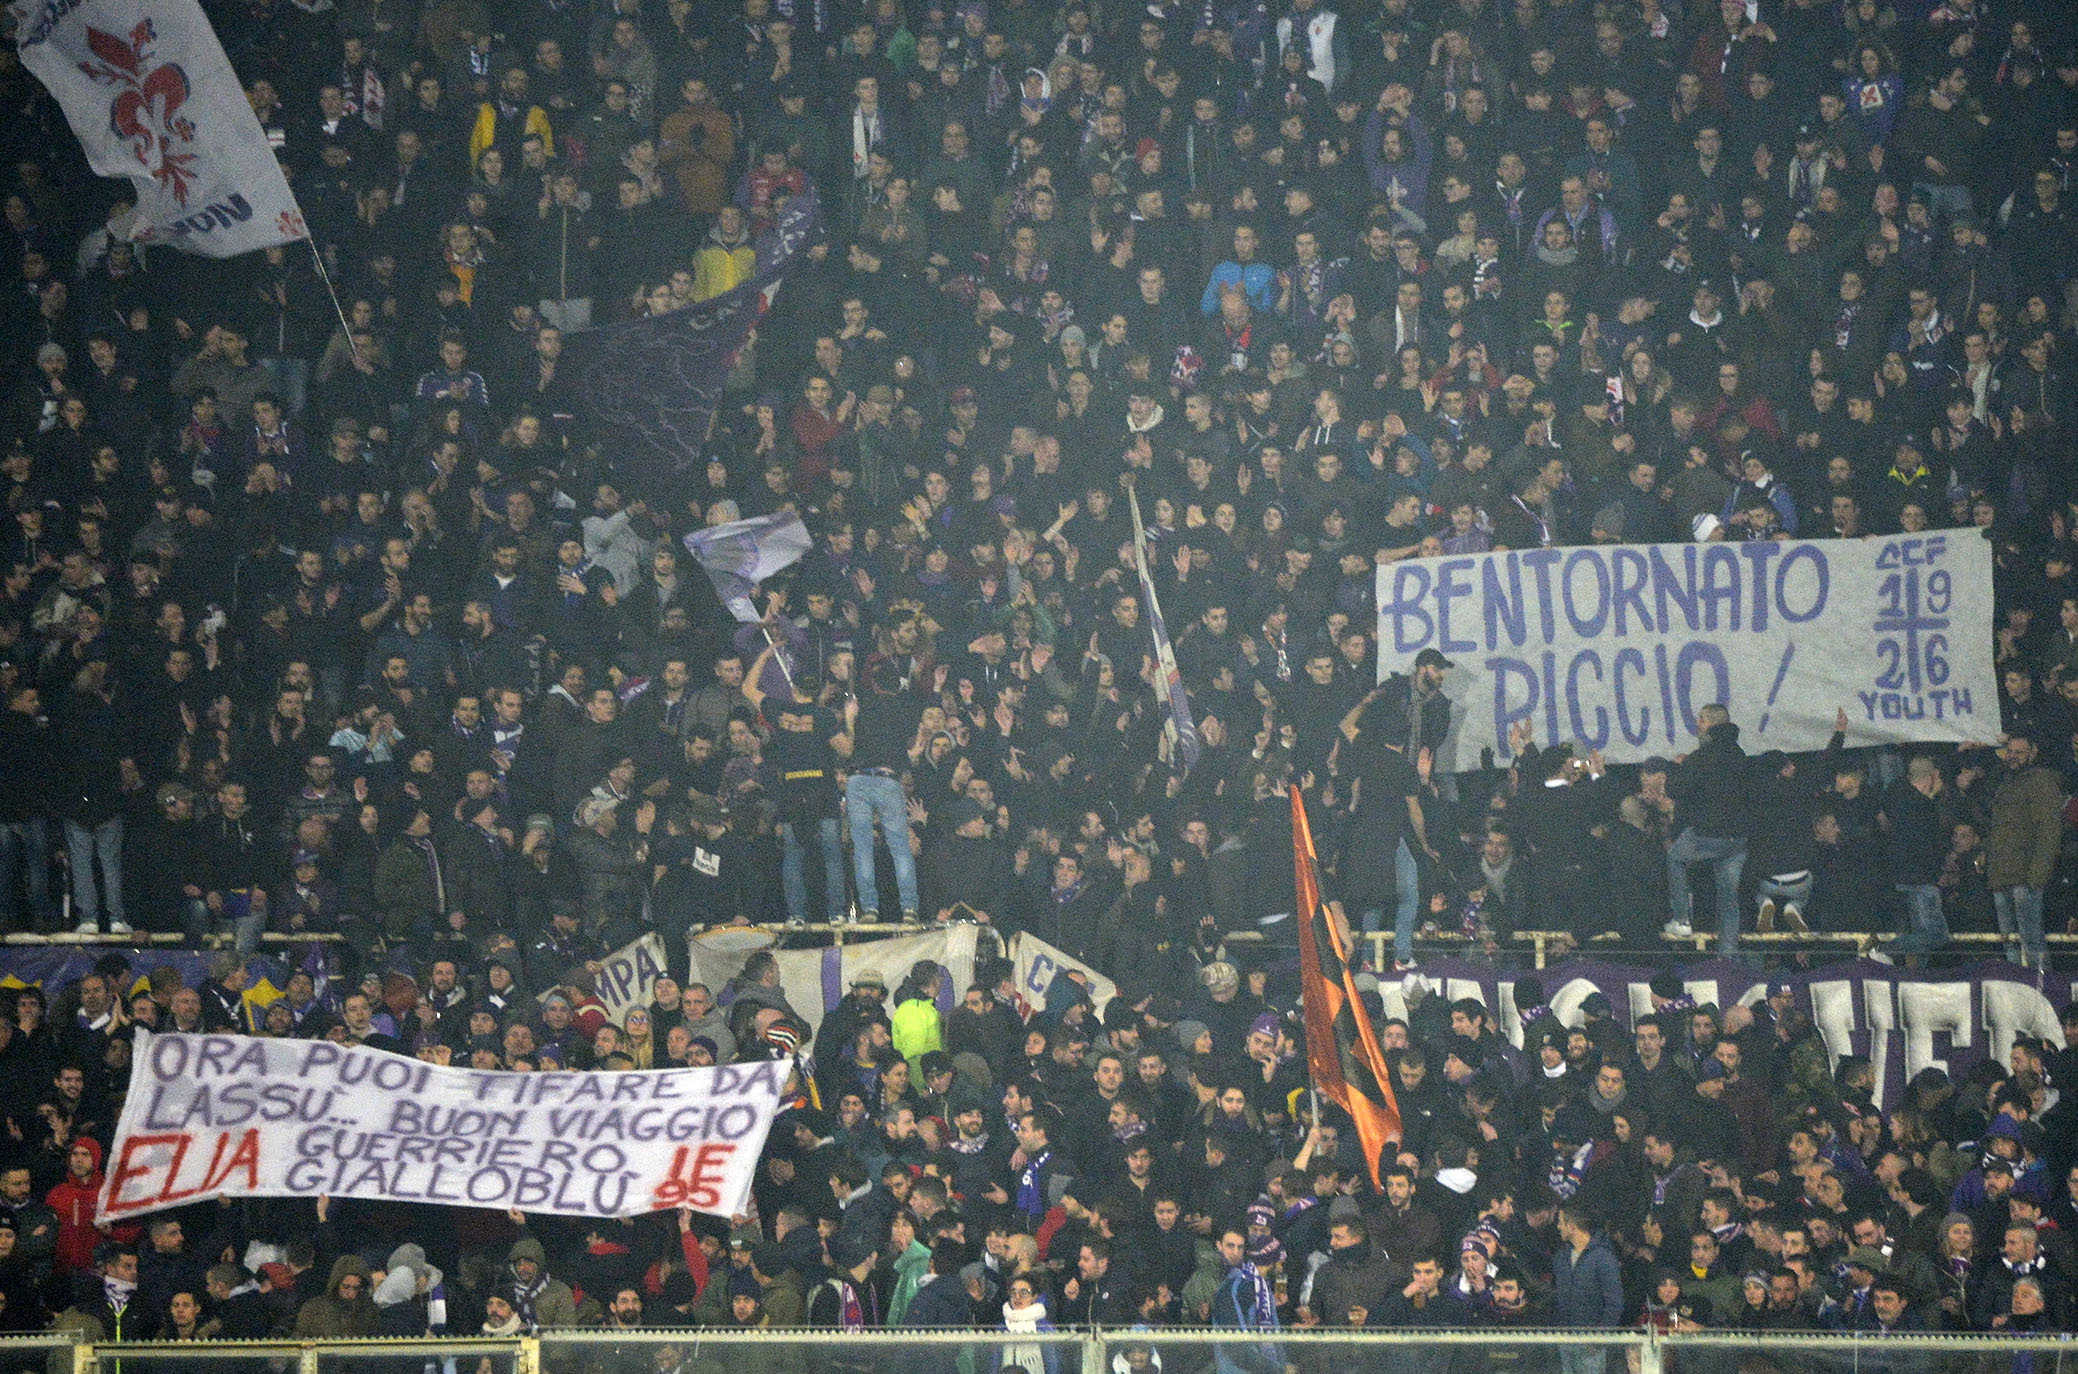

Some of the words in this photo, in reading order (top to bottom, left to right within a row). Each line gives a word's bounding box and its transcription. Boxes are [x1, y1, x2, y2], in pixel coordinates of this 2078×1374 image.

[1875, 535, 1948, 571] ACF
[1382, 542, 1830, 654] BENTORNATO
[1485, 640, 1730, 758] PICCIO
[1858, 687, 1973, 722] YOUTH
[152, 1035, 267, 1082] ORA
[300, 1042, 433, 1094] PUOI
[470, 1069, 693, 1105] TIFARE
[710, 1060, 778, 1097] DA
[390, 1098, 527, 1140] BUON
[549, 1104, 758, 1142] VIAGGIO
[103, 1127, 260, 1214] ELIA
[296, 1124, 628, 1175] GUERRIERO
[652, 1178, 721, 1210] 95
